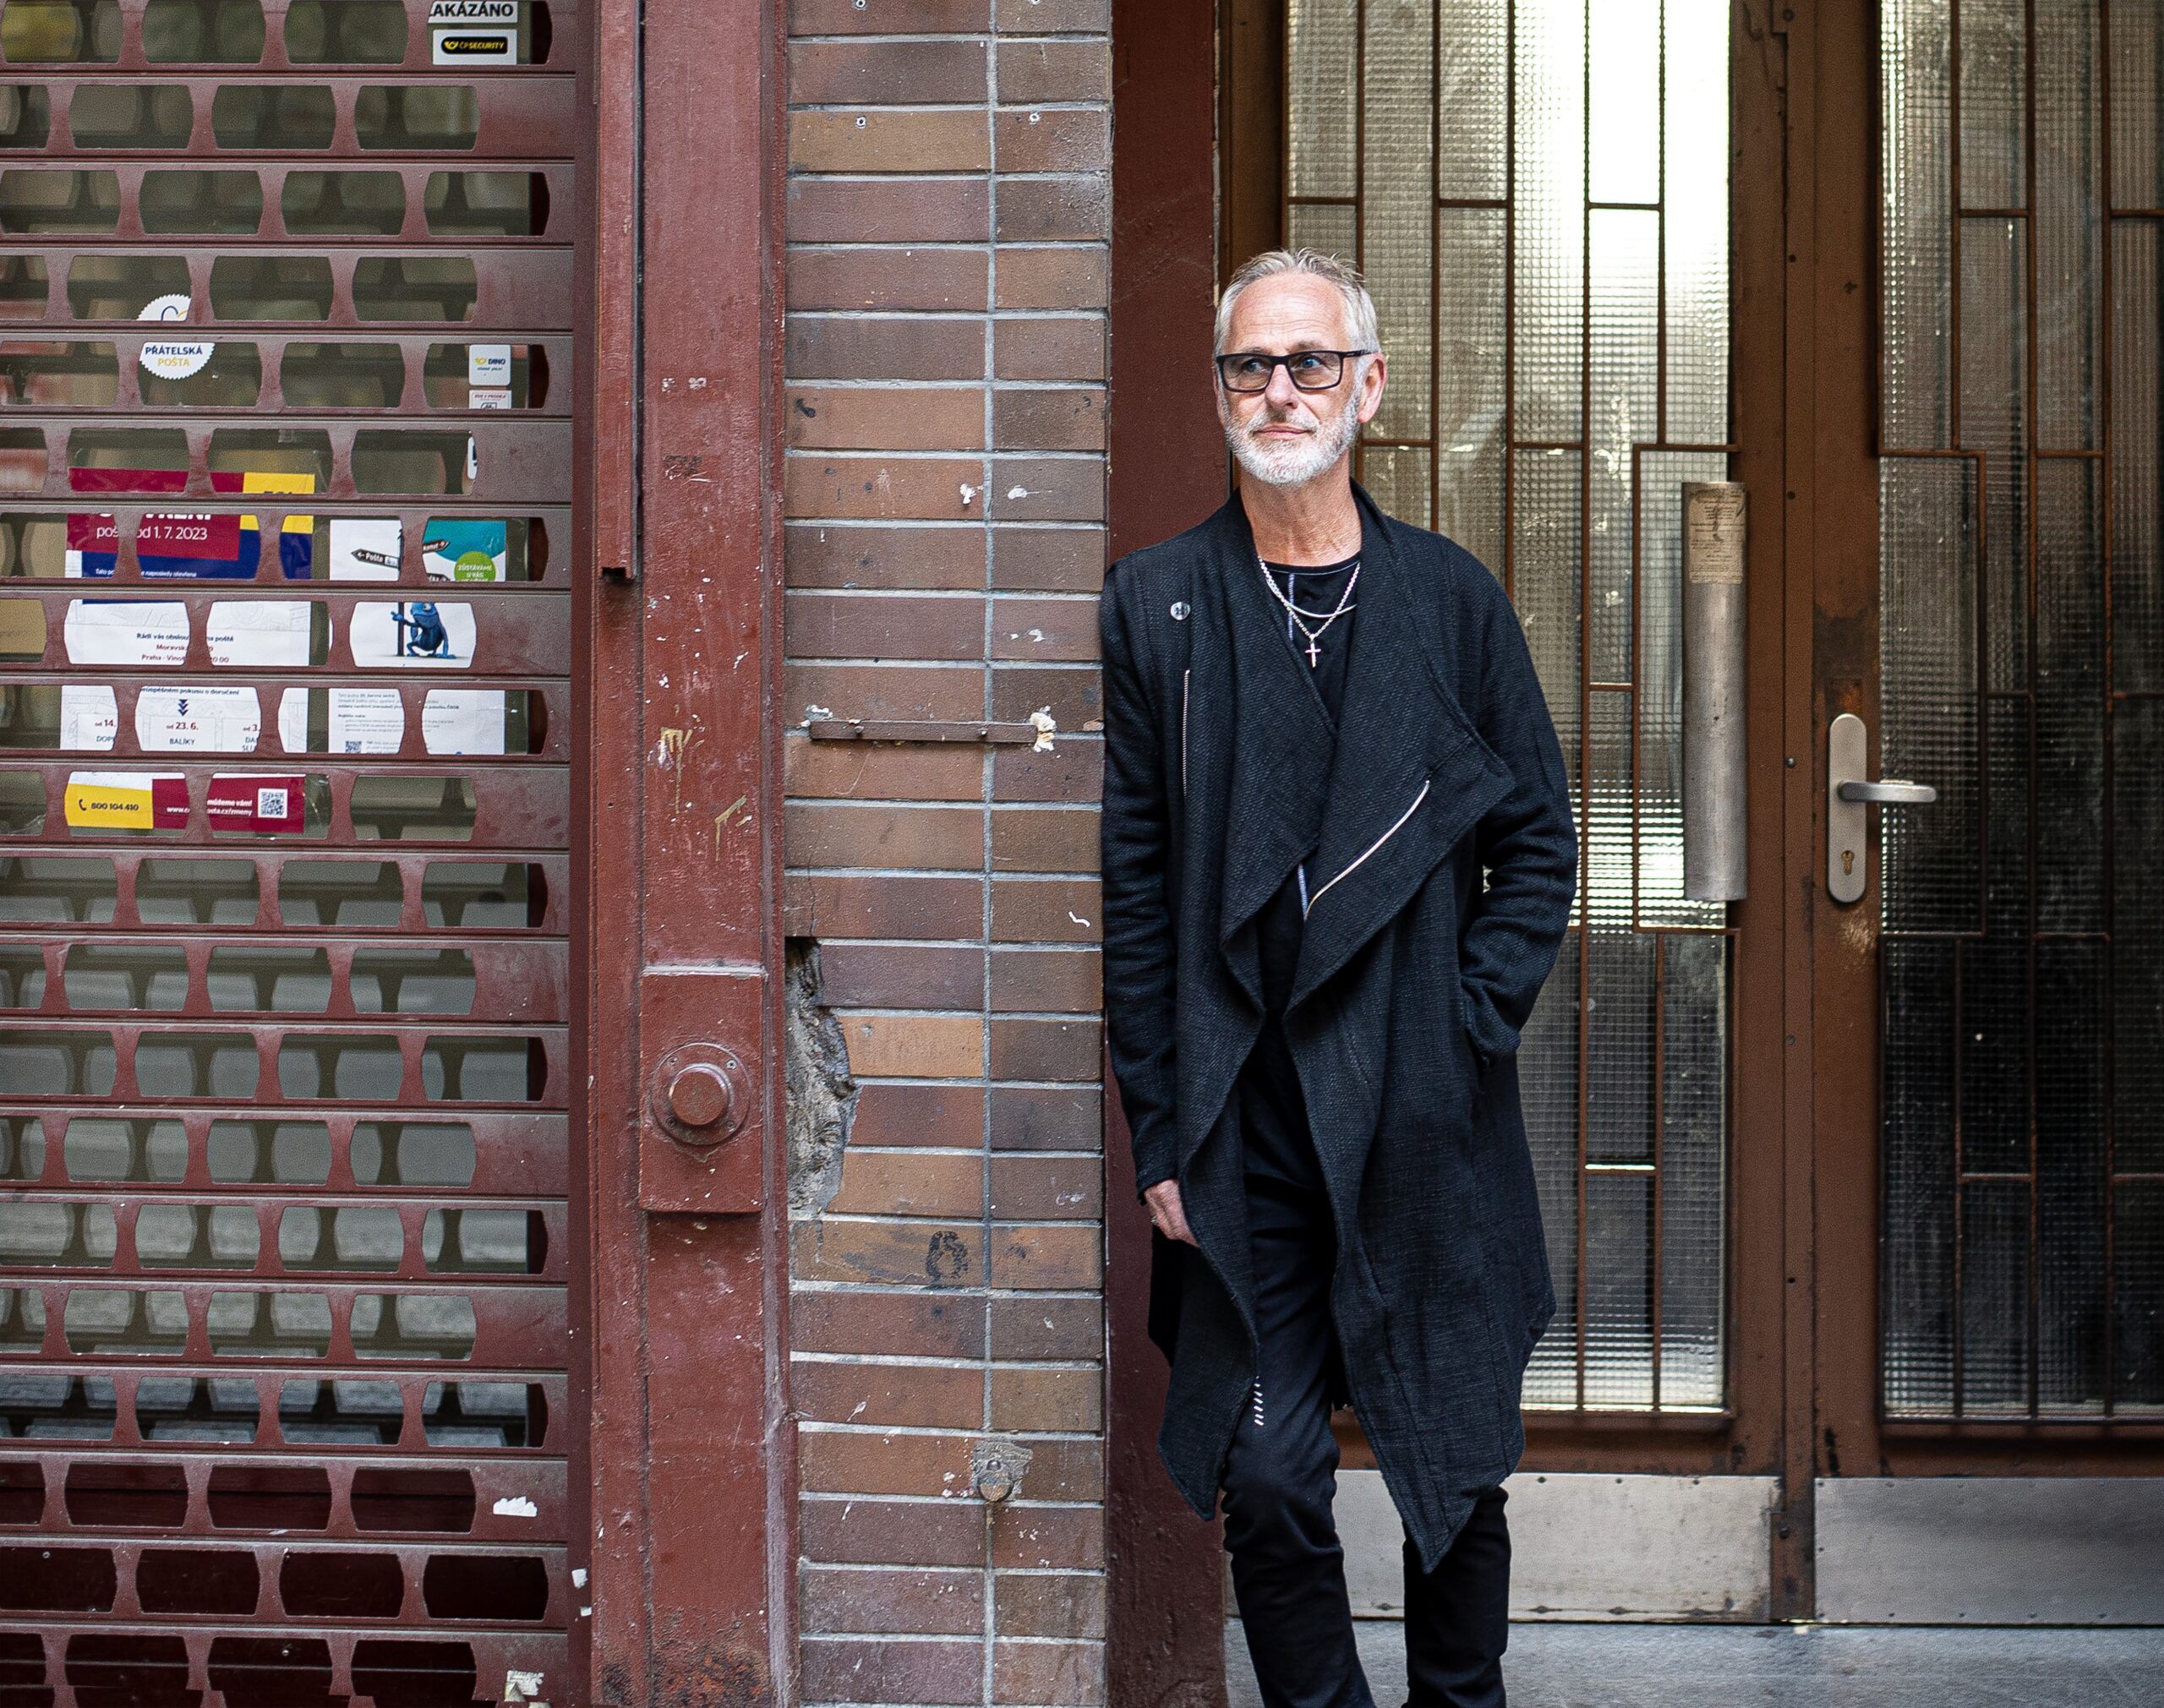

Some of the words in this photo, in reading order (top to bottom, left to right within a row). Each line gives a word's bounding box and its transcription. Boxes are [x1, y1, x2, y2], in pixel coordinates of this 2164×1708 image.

[429, 2, 514, 17] AKÁZÁNO
[145, 345, 203, 355] PŘÁTELSKÁ
[157, 357, 190, 367] POŠTA
[136, 526, 151, 538] od
[153, 526, 161, 539] 1.
[163, 526, 173, 539] 7.
[175, 527, 208, 540] 2023
[175, 722, 189, 730] 23.
